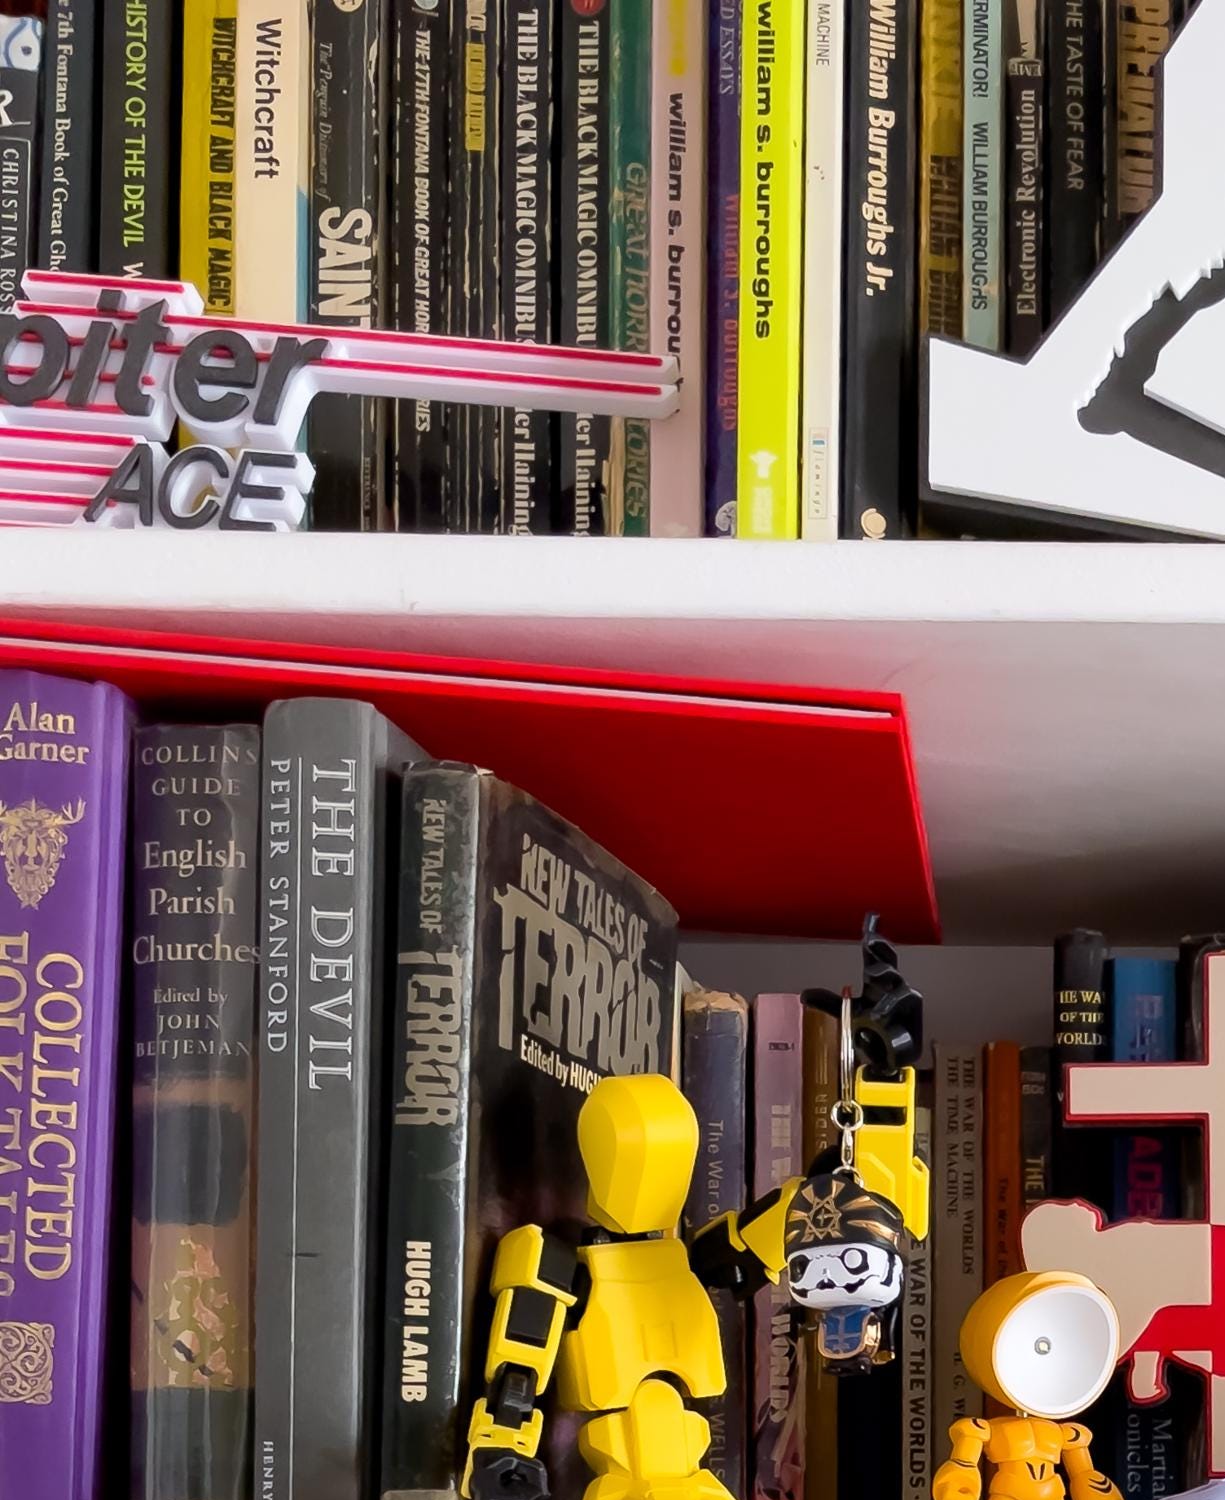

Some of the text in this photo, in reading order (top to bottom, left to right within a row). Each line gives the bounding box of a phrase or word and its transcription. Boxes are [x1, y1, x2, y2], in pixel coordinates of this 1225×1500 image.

[517, 9, 539, 60] THE
[816, 4, 831, 67] MACHINE
[124, 97, 146, 128] OF
[253, 18, 284, 180] Witchcraft
[515, 66, 538, 147] BLACK
[1064, 0, 1085, 191] HE TASTE OF FEAR
[124, 134, 146, 178] THE
[207, 17, 237, 307] WITCHCRAFT AND BLACK MAGIC
[752, 1, 776, 340] william s. burroughs
[862, 0, 896, 297] William Burroughs Jr.
[971, 0, 990, 311] RMINATOR! WILLIAM BURROUGHS
[123, 184, 146, 248] DEVIL
[515, 152, 537, 233] MAGIC
[1015, 89, 1038, 316] Electronic Revolution
[83, 442, 310, 532] ACE
[0, 735, 91, 766] Garner
[6, 701, 76, 735] Alan
[141, 745, 259, 766] COLLINS
[152, 777, 242, 797] GUIDE
[176, 809, 212, 827] TO
[144, 840, 249, 877] English
[418, 797, 447, 935] NEW TALES OF
[149, 888, 238, 916] Parish
[267, 758, 292, 1053] PETER STANFORD
[308, 758, 358, 1091] THE DEVIL
[133, 935, 262, 966] Churches
[492, 882, 662, 1078] TERROR
[153, 988, 229, 1010] Edited by
[157, 1013, 221, 1034] JOHN
[395, 944, 464, 1127] TERROR
[136, 1041, 252, 1058] BETJEMAN
[25, 952, 85, 1281] COLLECTED
[401, 1240, 432, 1402] HUGH LAMB
